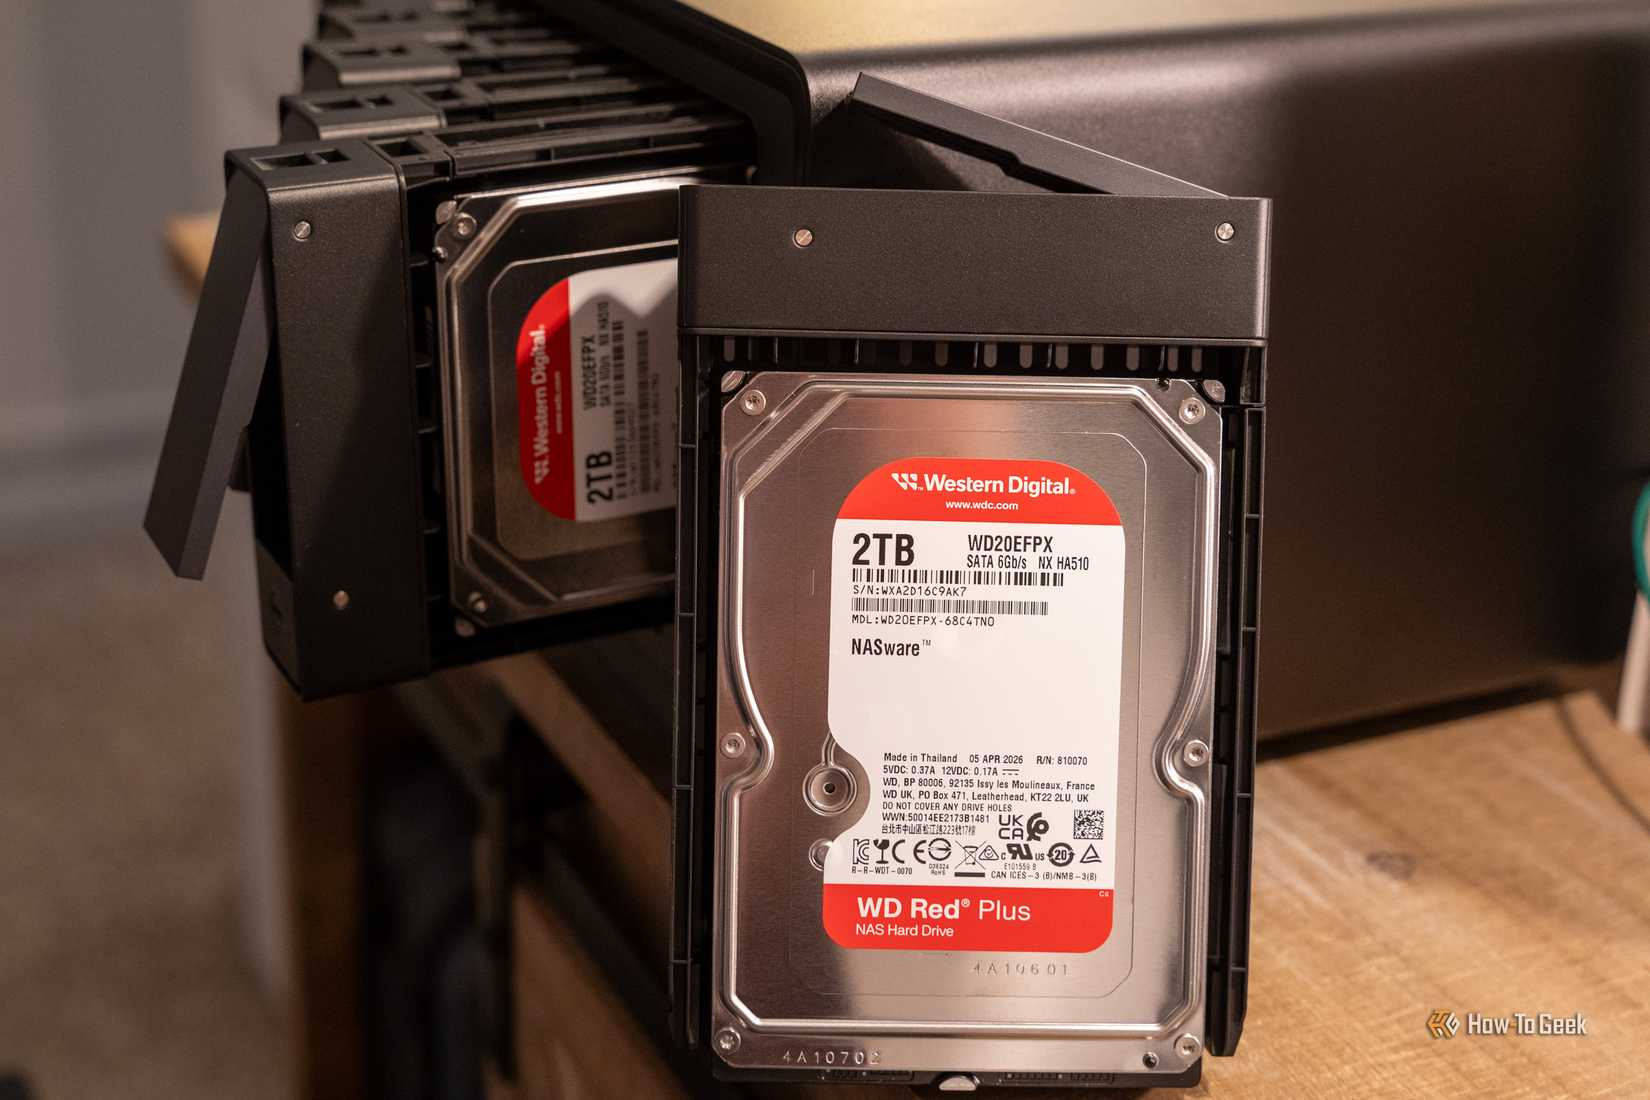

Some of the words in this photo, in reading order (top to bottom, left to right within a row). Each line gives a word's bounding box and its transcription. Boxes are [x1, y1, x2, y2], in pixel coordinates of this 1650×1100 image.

[585, 451, 613, 504] 2TB
[924, 473, 1004, 493] Western
[945, 501, 1018, 511] www.wdc.com
[852, 533, 915, 567] 2TB
[968, 534, 1053, 553] WD20EFPX
[966, 555, 994, 569] SATA
[998, 555, 1027, 570] 6Gb/s
[1038, 556, 1053, 570] NX
[1057, 557, 1089, 571] HA510
[884, 752, 907, 762] Made
[910, 752, 918, 762] in
[920, 753, 958, 763] Thailand
[969, 754, 979, 763] 05
[982, 754, 1000, 764] APR
[1003, 755, 1024, 764] 2026
[1036, 755, 1054, 765] R/N:
[1057, 756, 1088, 765] 810070
[911, 765, 935, 775] 0.37A
[974, 766, 998, 776] 0.17A
[903, 778, 915, 787] BP
[949, 779, 974, 788] 92135
[977, 779, 994, 790] Issy
[996, 780, 1009, 789] les
[1012, 780, 1064, 791] Moulineaux,
[1066, 781, 1095, 790] France
[883, 789, 897, 799] WD
[918, 790, 930, 799] PO
[933, 790, 949, 800] Box
[972, 791, 1027, 802] Leatherhead,
[1030, 792, 1052, 802] KT22
[1077, 793, 1089, 802] UK
[882, 802, 893, 810] DO
[896, 802, 911, 810] NOT
[914, 802, 940, 811] COVER
[943, 802, 959, 811] ANY
[961, 803, 984, 811] DRIVE
[988, 803, 1013, 812] HOLES
[998, 814, 1024, 826] UK
[998, 827, 1024, 840] CA
[1054, 849, 1068, 861] 20
[990, 870, 1007, 879] CAN
[857, 896, 902, 918] WD
[978, 899, 1031, 921] Plus
[855, 923, 885, 936] NAS
[887, 924, 919, 936] Hard
[921, 924, 954, 937] Drive
